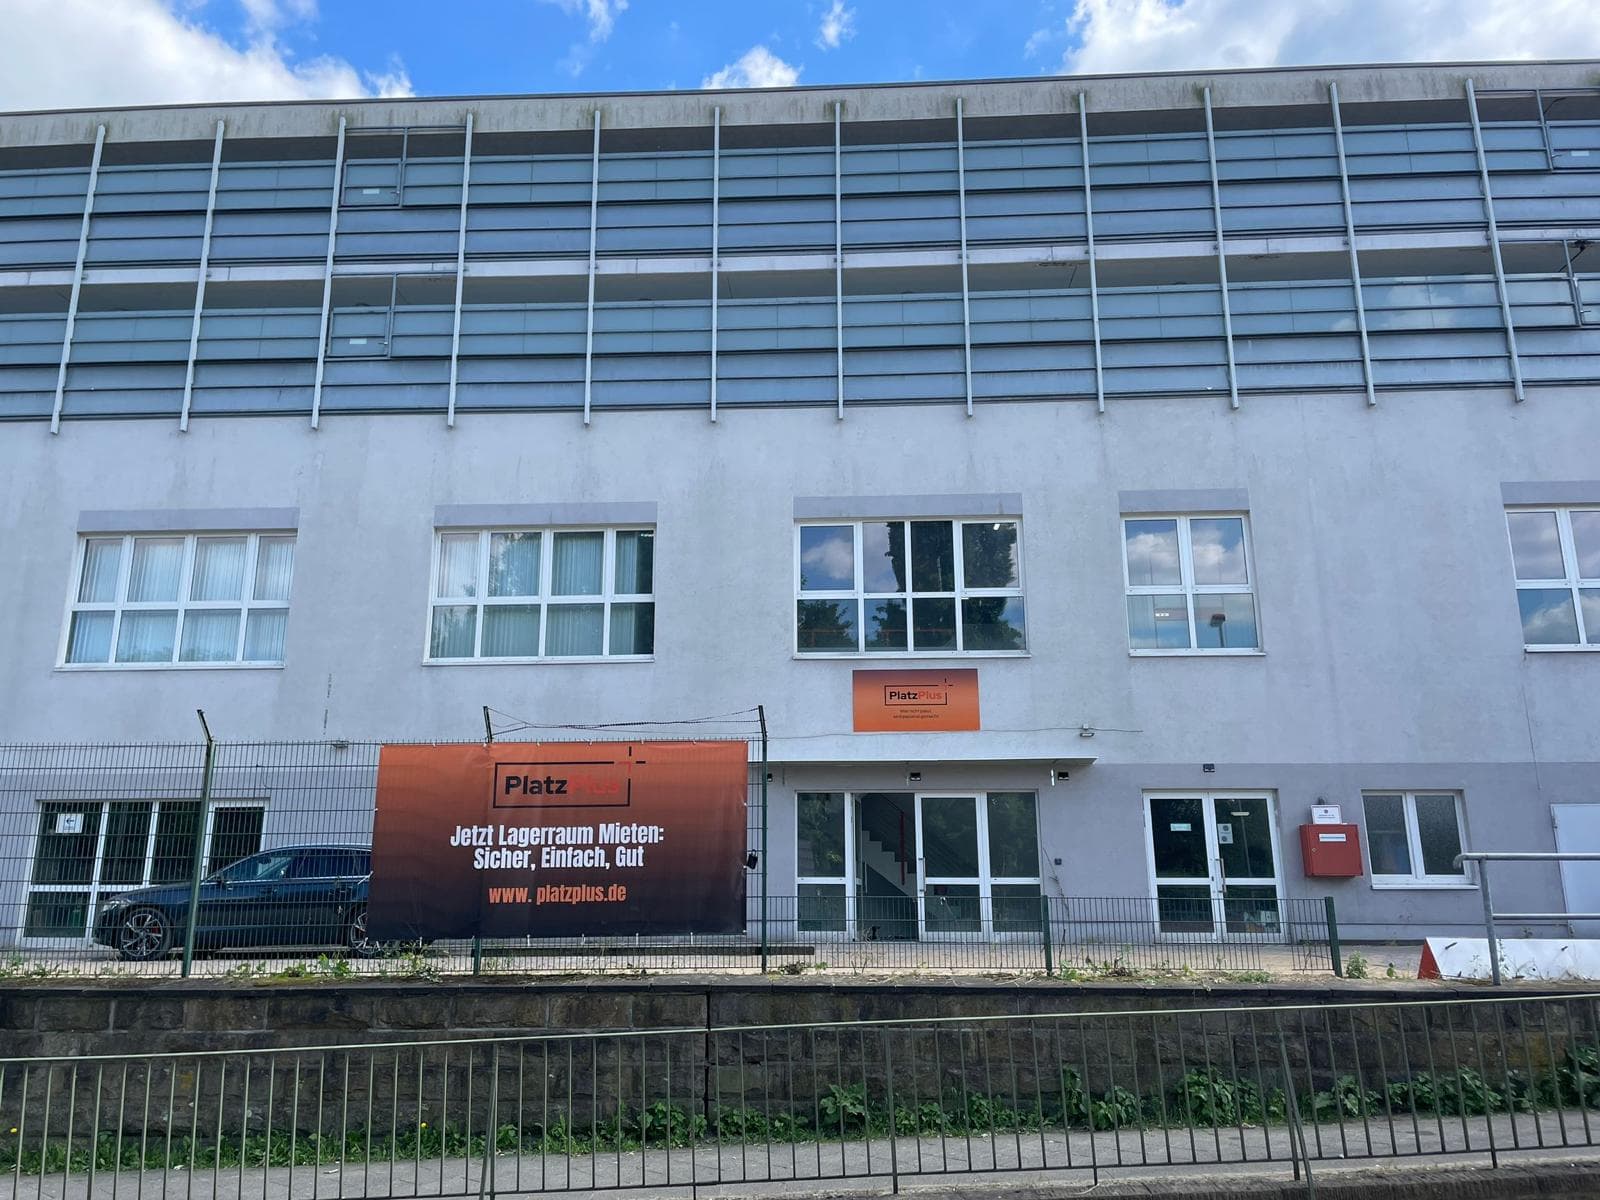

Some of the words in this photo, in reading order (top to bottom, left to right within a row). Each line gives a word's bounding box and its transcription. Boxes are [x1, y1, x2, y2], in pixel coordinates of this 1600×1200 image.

[889, 691, 942, 700] PlatzPlus
[504, 774, 620, 795] PlatzPlus
[450, 825, 494, 846] Jetzt
[499, 824, 594, 848] Lagerraum
[599, 822, 665, 844] Mieten:
[473, 847, 536, 871] Sicher,
[541, 846, 610, 870] Einfach,
[615, 845, 645, 867] Gut
[488, 887, 532, 903] www.
[536, 884, 627, 905] platzplus.de
